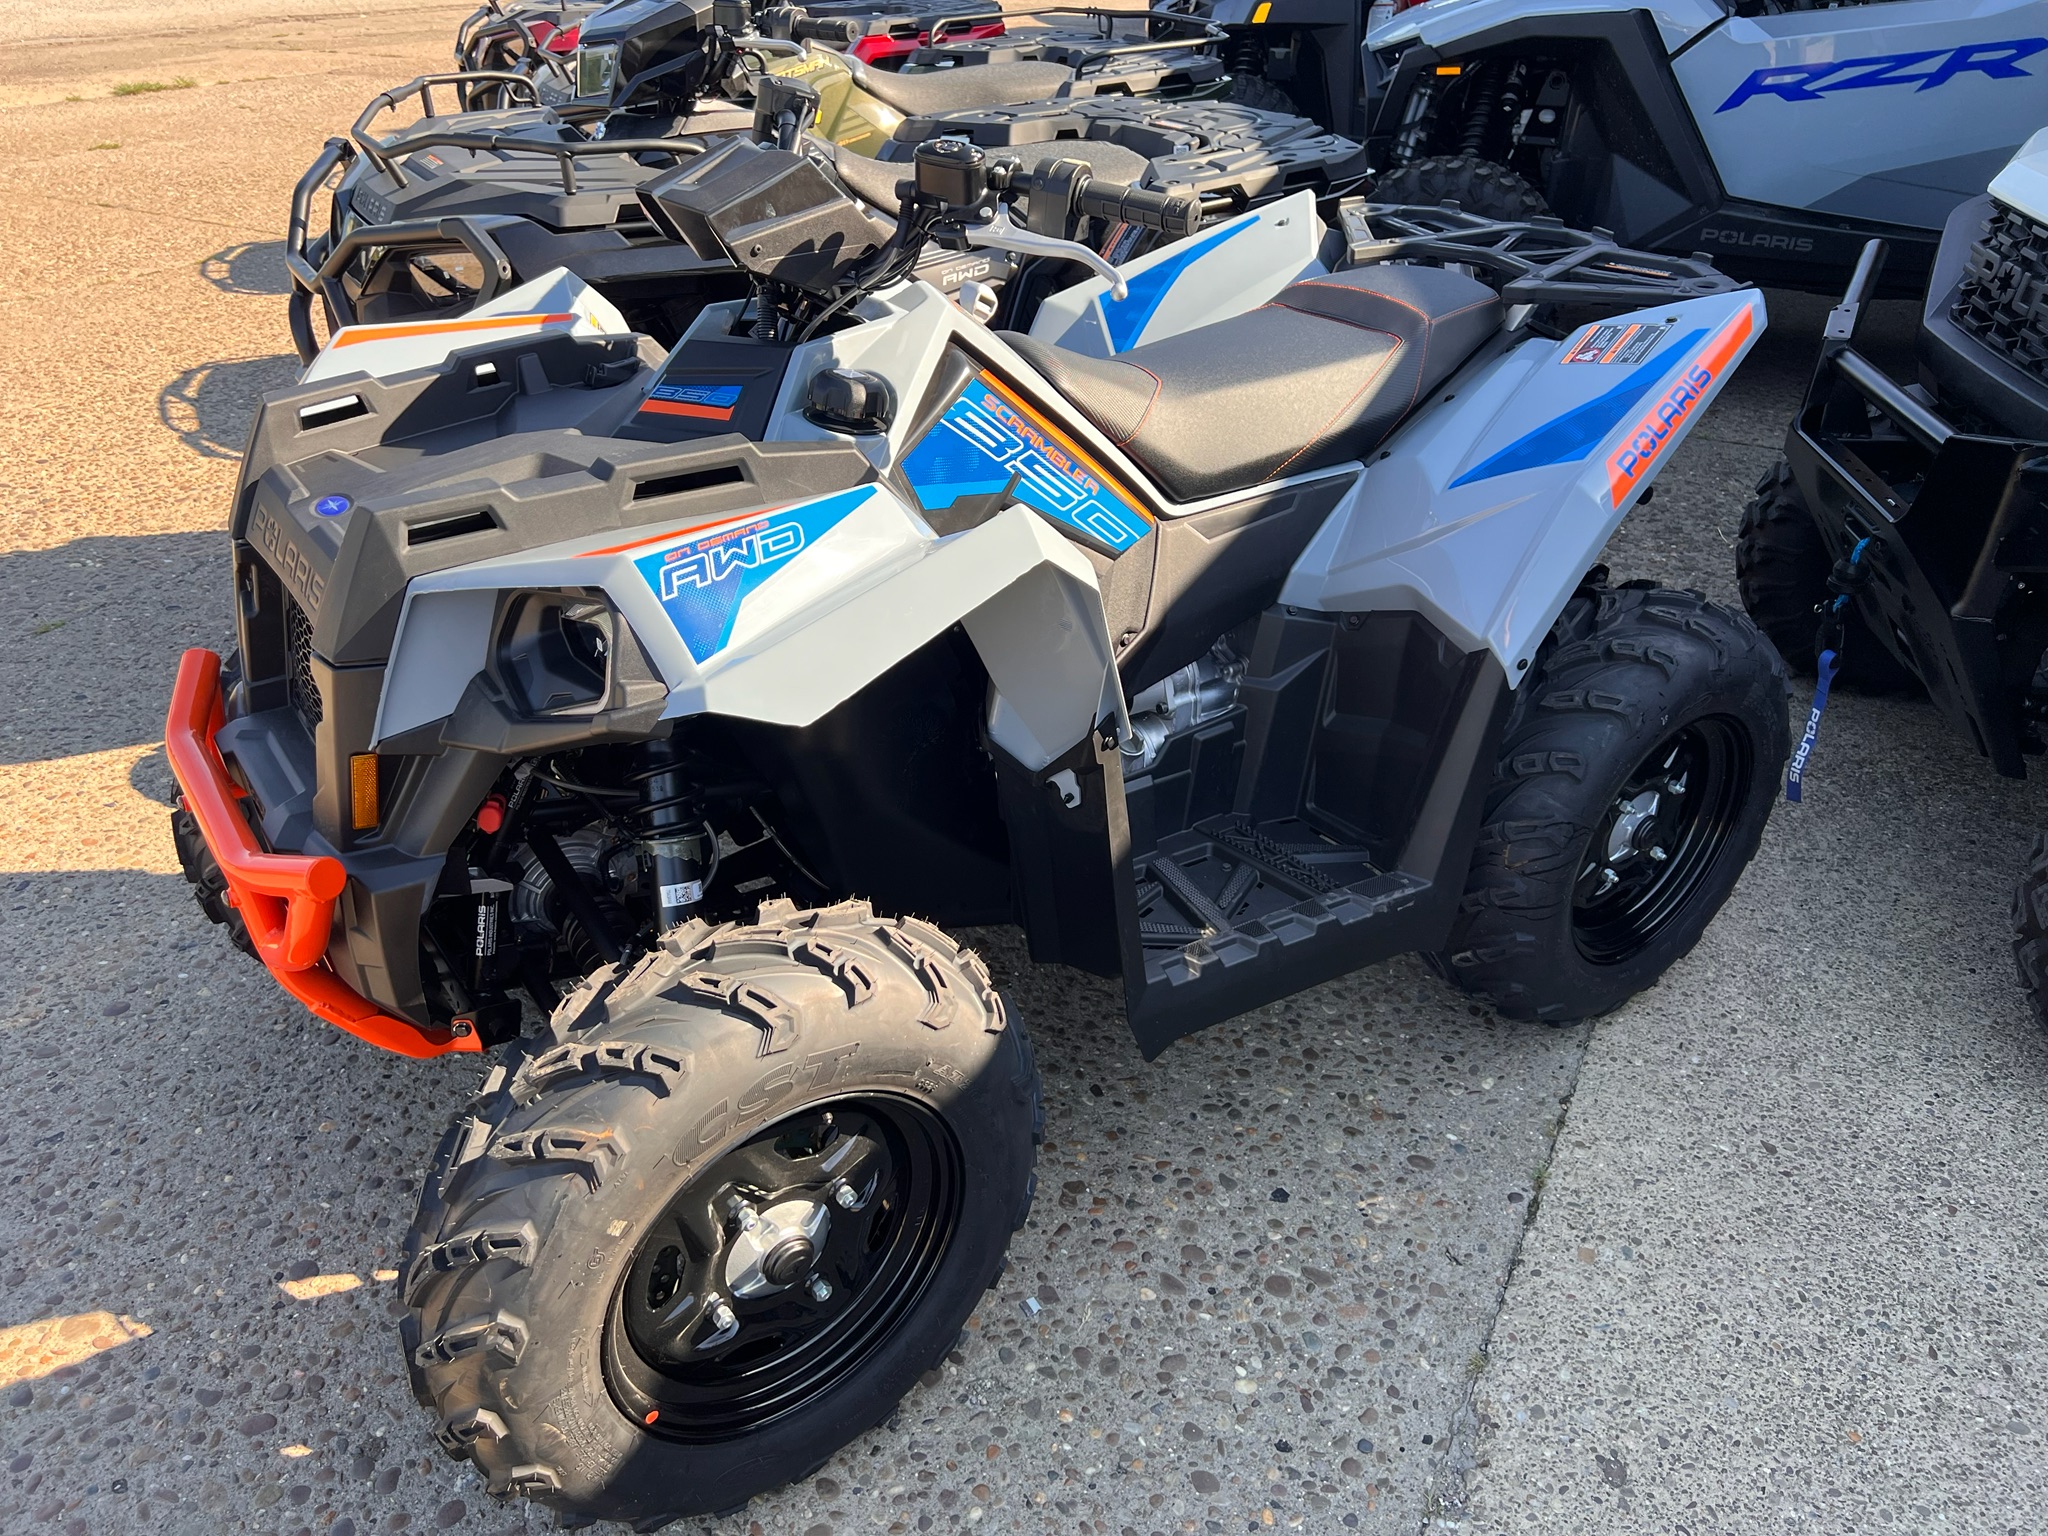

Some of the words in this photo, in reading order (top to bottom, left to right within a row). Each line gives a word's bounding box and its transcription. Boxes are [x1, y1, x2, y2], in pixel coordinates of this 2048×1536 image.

[1713, 37, 2048, 115] RZR
[943, 263, 990, 286] AWD
[1700, 228, 1814, 251] POLARIS
[650, 385, 738, 404] 850
[1616, 365, 1711, 479] POLARIS
[940, 397, 1140, 548] 850
[980, 393, 1100, 496] SCRAMBLER
[251, 502, 324, 612] POLARIS
[659, 522, 805, 601] AWD
[664, 547, 690, 562] ON
[697, 520, 769, 550] DEMAND
[1789, 707, 1820, 783] POLARIS
[475, 905, 486, 956] POLARIS
[671, 1041, 862, 1167] CST
